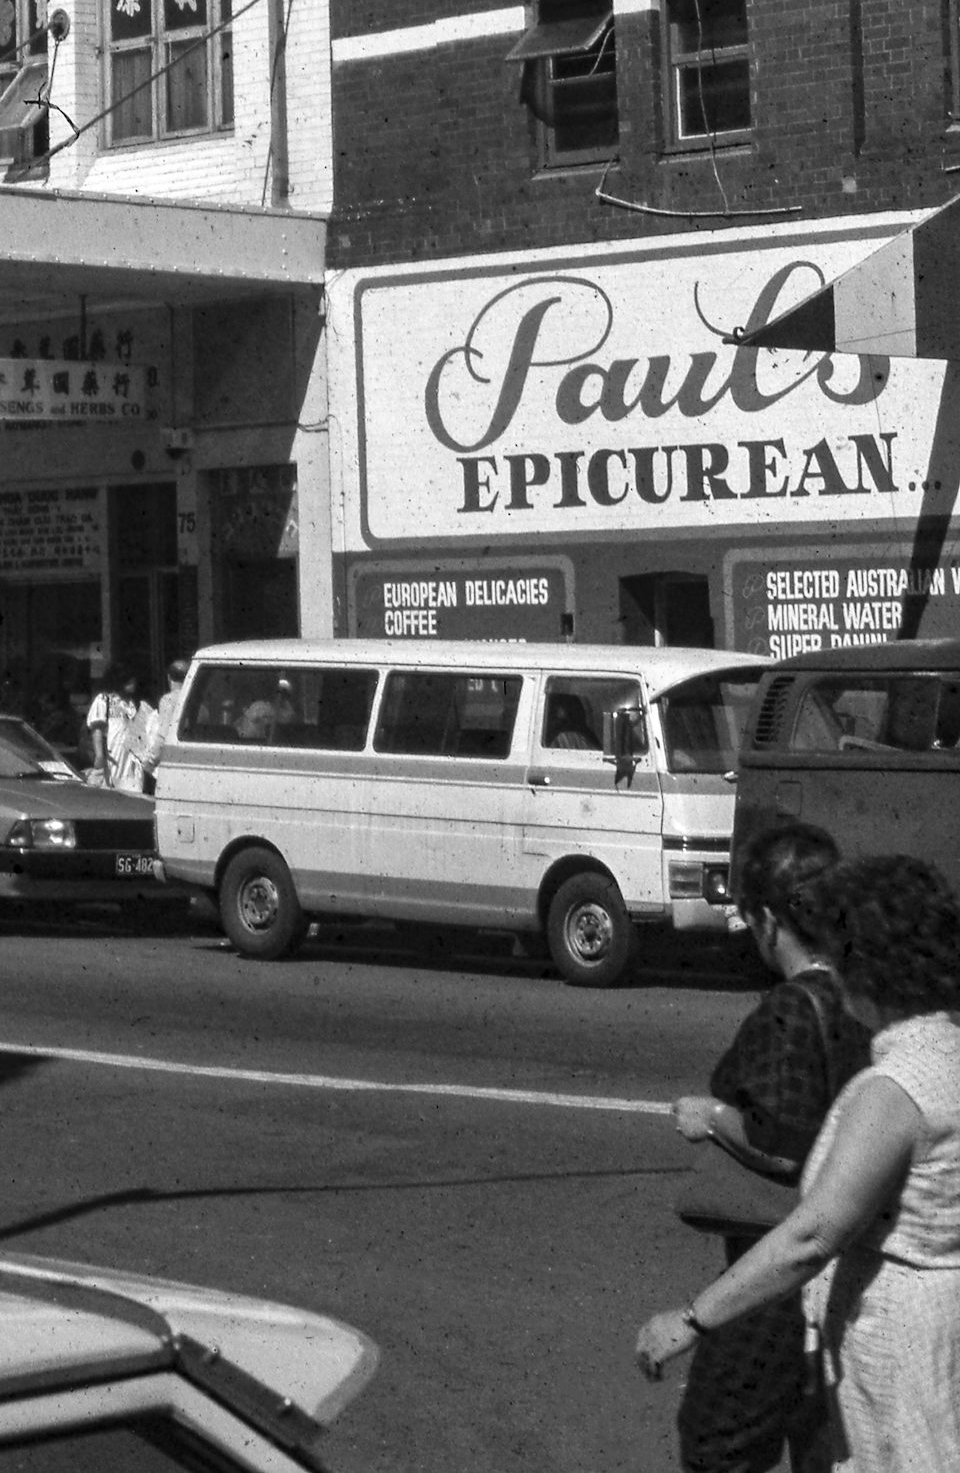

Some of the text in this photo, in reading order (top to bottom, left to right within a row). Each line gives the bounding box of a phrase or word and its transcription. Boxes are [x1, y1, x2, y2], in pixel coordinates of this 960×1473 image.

[425, 260, 891, 453] Pauls
[50, 403, 66, 415] and
[70, 401, 116, 416] HERBS
[121, 402, 141, 416] CO
[383, 577, 550, 608] EUROPEAN DELICACIES
[766, 569, 840, 600] SELECTED
[846, 567, 945, 598] AUSTRALIAN
[384, 609, 438, 636] COFFEE
[767, 601, 903, 631] MINERAL WATER
